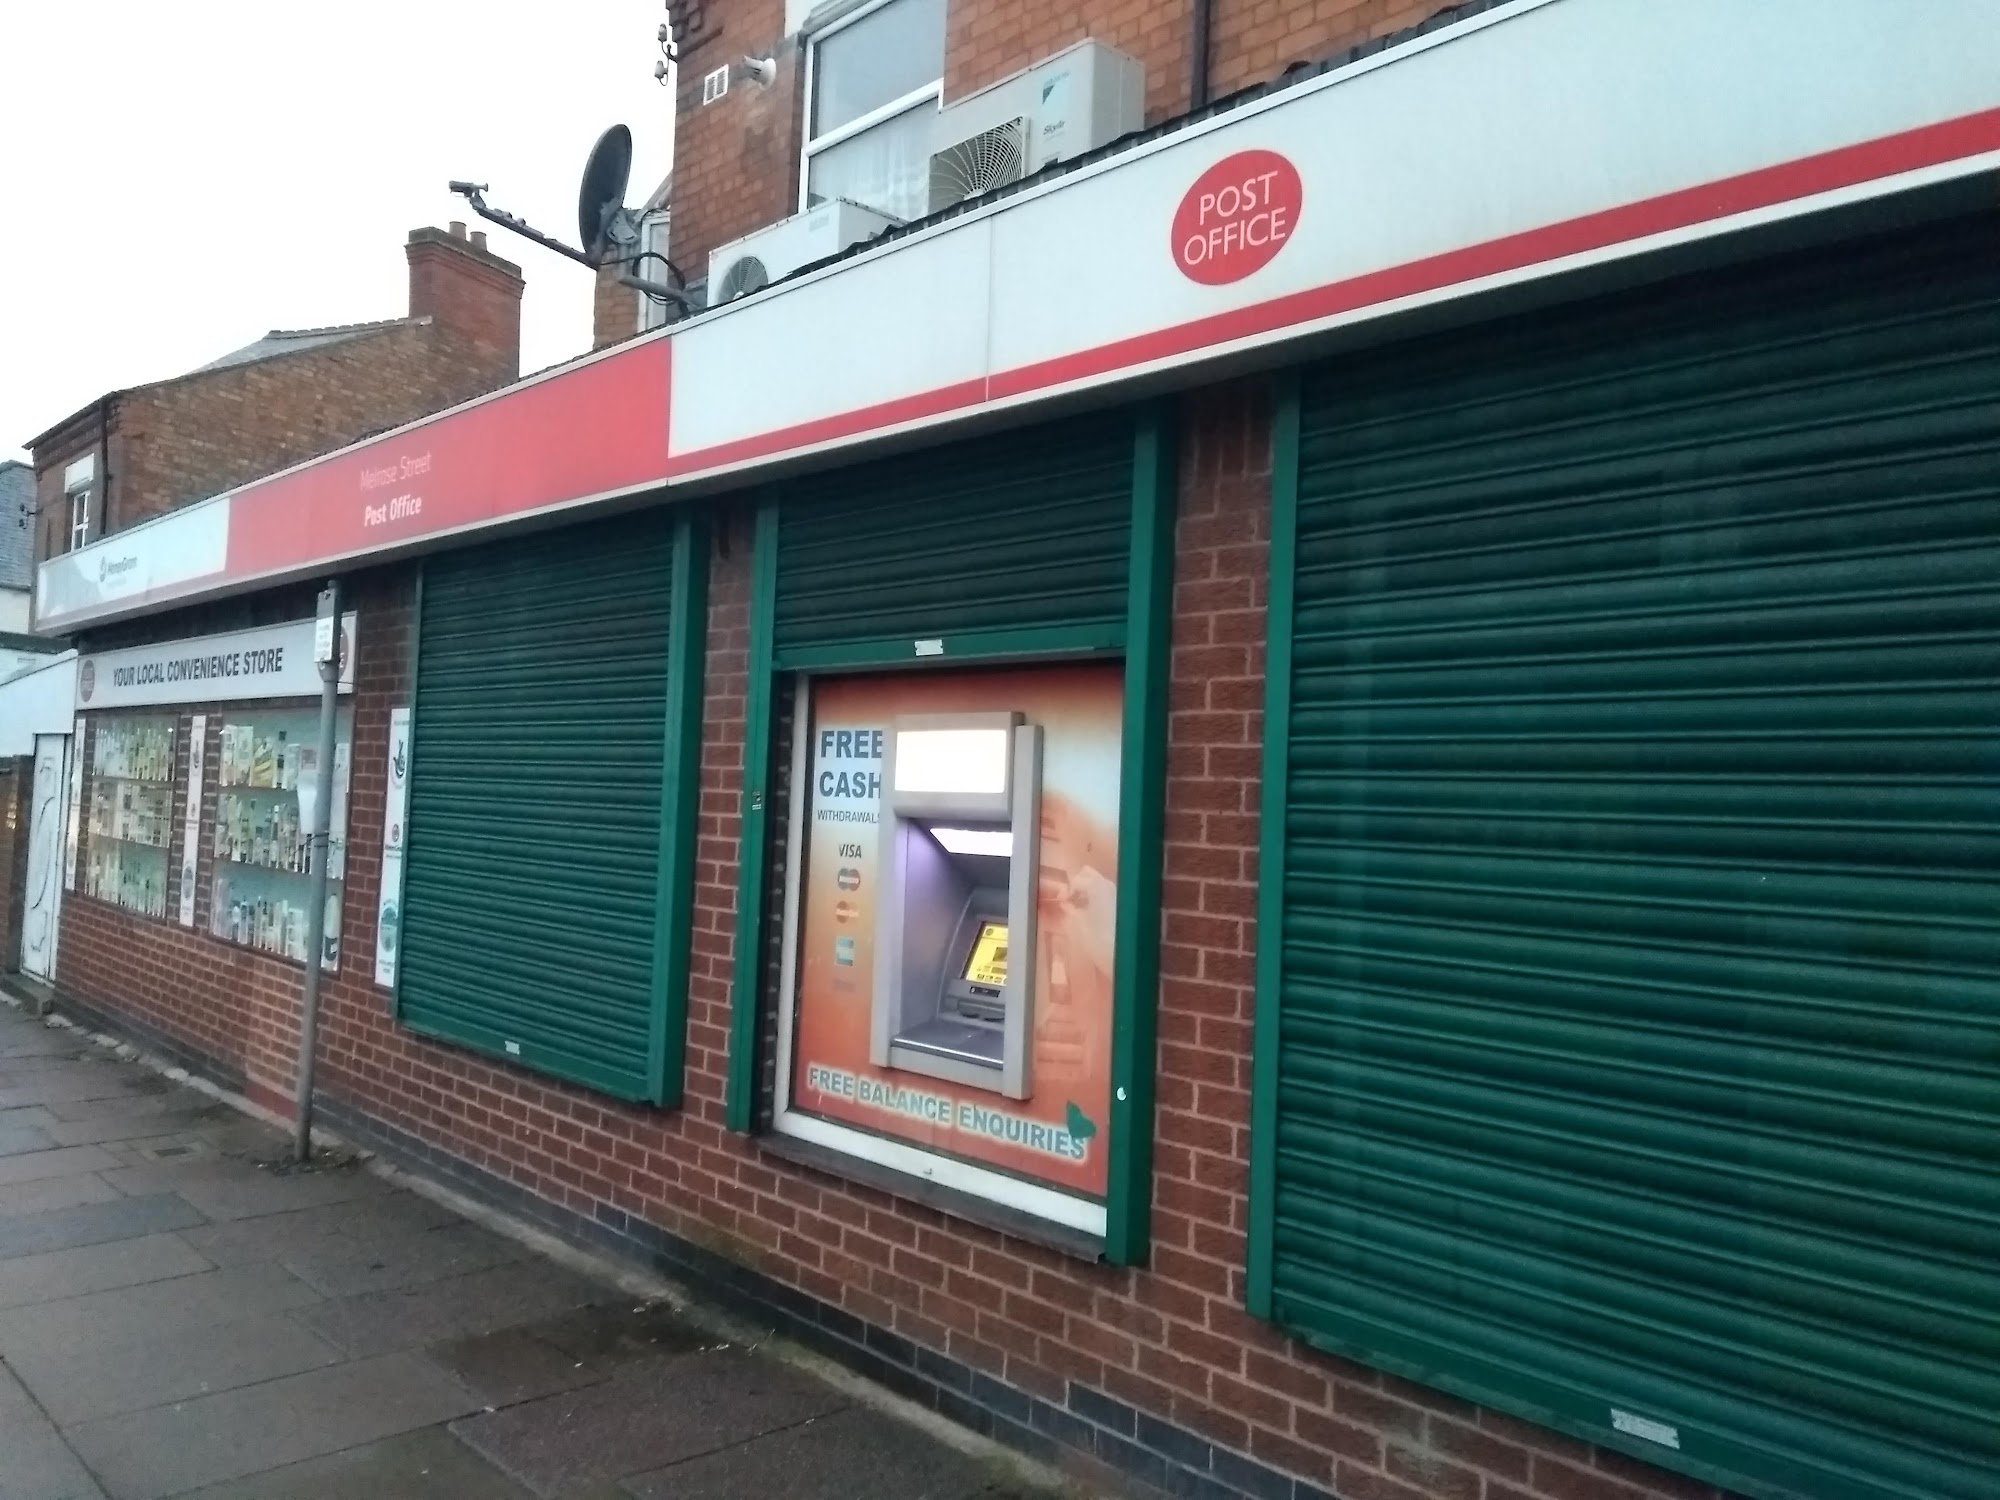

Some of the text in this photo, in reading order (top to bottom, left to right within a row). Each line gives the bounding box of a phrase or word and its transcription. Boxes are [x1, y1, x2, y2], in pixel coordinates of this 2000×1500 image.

[1199, 170, 1278, 226] POST
[1184, 206, 1287, 265] OFFICE
[400, 450, 431, 480] Street
[364, 493, 422, 527] Post Office
[113, 667, 135, 687] YOUR
[137, 662, 165, 685] LOCAL
[167, 652, 240, 682] CONVENIENCE
[243, 647, 283, 675] STORE
[820, 730, 883, 758] FREE
[819, 771, 881, 799] CASH
[839, 844, 862, 859] VISA
[810, 1067, 1086, 1159] FREE BALANCE ENQUIRIES
